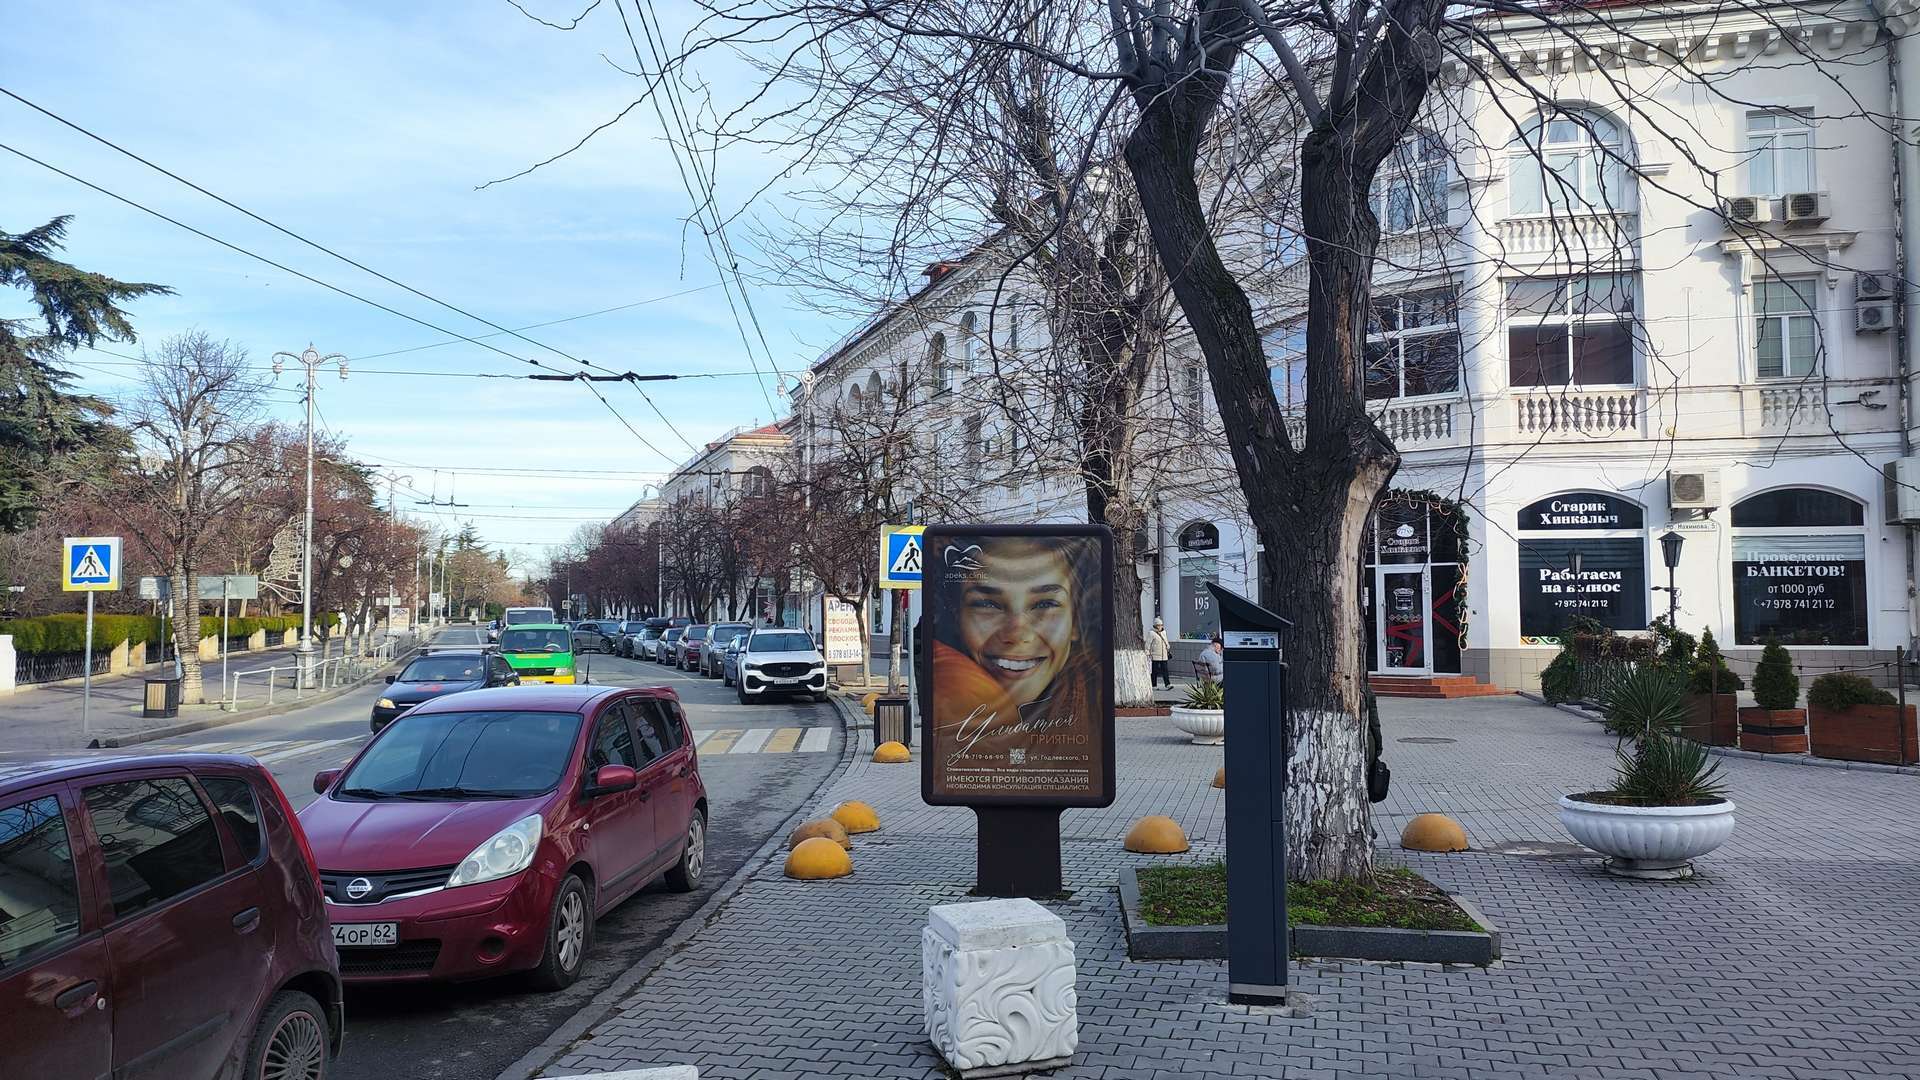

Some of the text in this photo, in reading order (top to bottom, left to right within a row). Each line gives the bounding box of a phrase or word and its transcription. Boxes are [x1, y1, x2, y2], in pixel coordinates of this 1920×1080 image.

[1551, 501, 1606, 514] Старик
[1540, 513, 1618, 525] Хинкалыч
[1747, 551, 1845, 564] Проведение
[1747, 565, 1845, 577] БАНКЕТОВ!
[1541, 584, 1562, 593] на
[1767, 583, 1825, 596] от 1000 руб
[1194, 597, 1210, 610] 195
[1760, 600, 1835, 608] +7 978 741 21 12
[1031, 734, 1088, 745] ПРИЯТНО!
[946, 775, 990, 783] ИМЕЮТСЯ
[992, 775, 1089, 784] ПРОТИВОПОКАЗАНИЯ
[373, 925, 391, 938] 62
